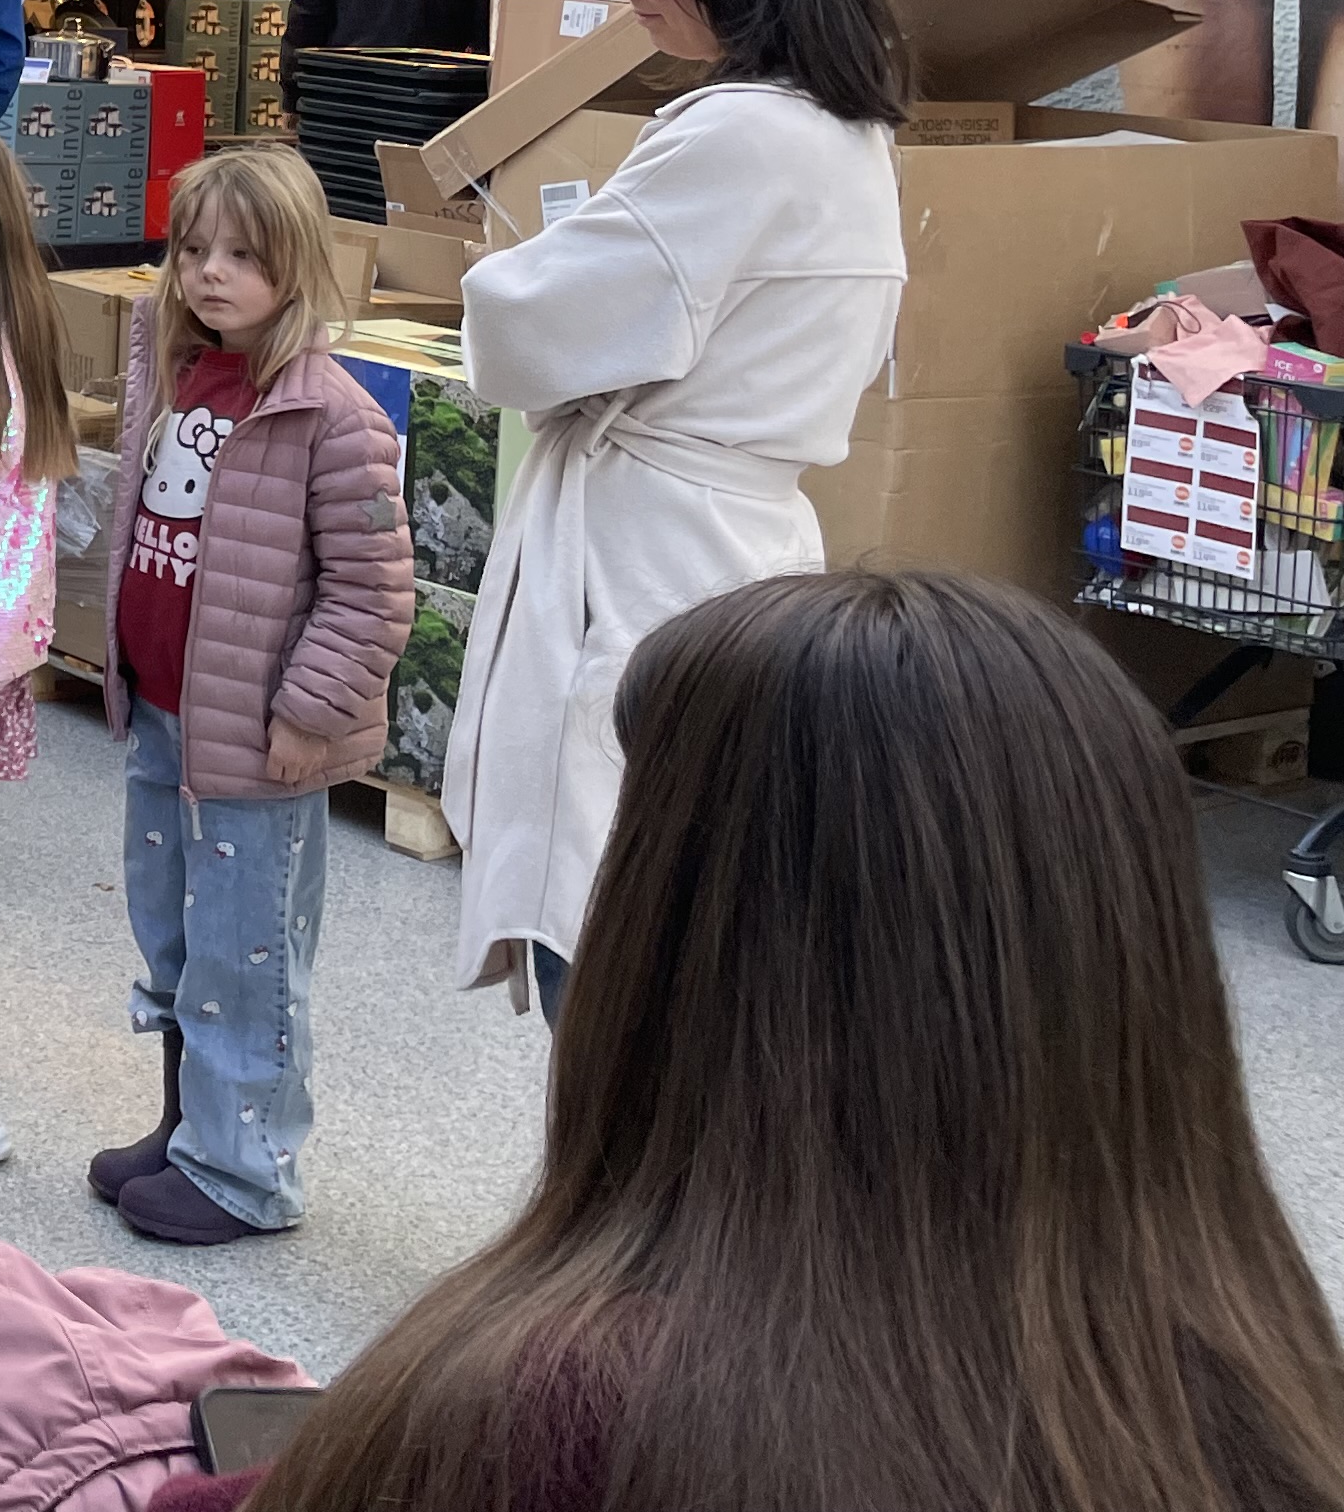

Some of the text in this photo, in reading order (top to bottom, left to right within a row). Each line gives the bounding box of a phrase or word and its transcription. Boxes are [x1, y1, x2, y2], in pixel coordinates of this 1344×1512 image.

[56, 88, 83, 159] invite
[124, 88, 149, 159] invite
[51, 168, 76, 239] invite
[119, 167, 144, 237] invite
[1274, 359, 1294, 373] ICE
[130, 543, 196, 587] ITTY
